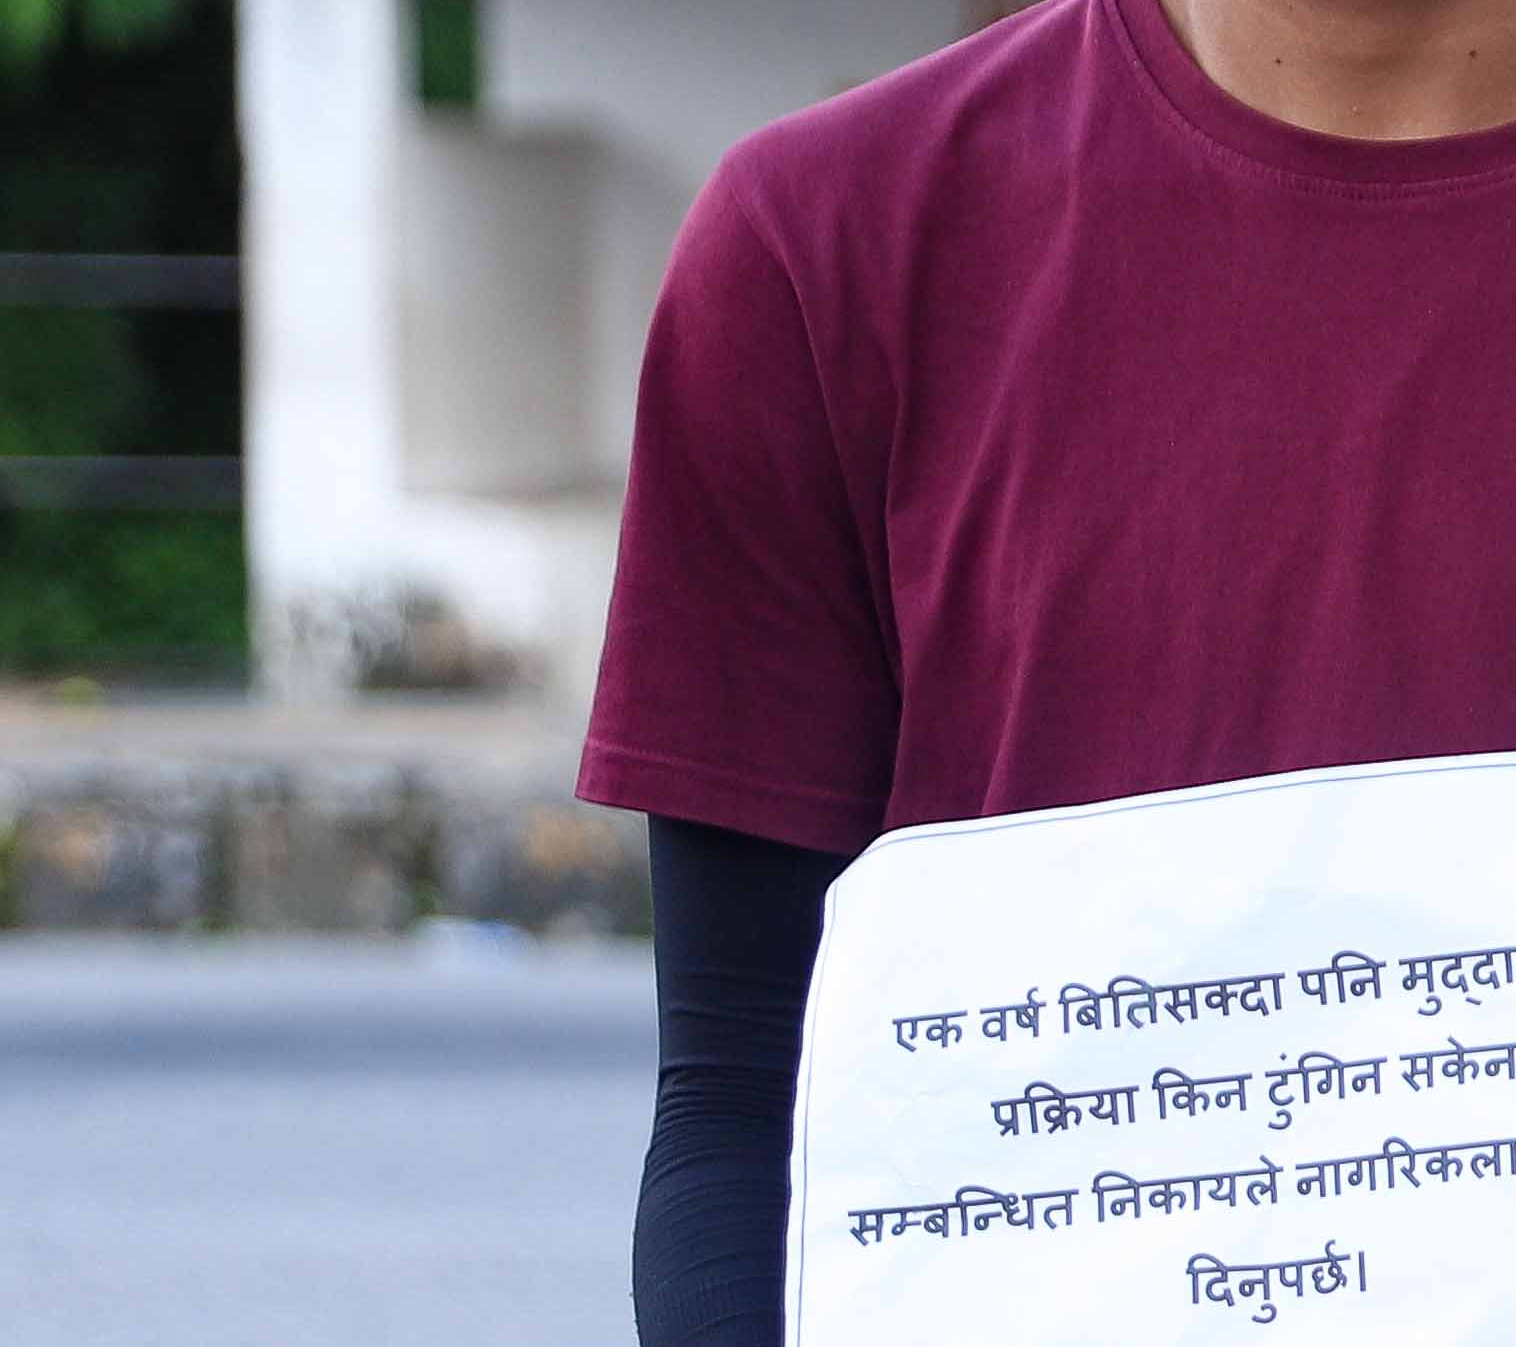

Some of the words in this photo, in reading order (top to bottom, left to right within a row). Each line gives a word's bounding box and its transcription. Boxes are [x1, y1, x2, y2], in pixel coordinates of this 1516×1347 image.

[892, 1010, 968, 1052] एक
[979, 987, 1047, 1041] वर्ष
[1058, 974, 1286, 1034] बितिसक्दा
[1297, 950, 1387, 1006] पनि
[991, 1080, 1139, 1137] प्रक्रिया
[1152, 1067, 1252, 1119] किन
[1265, 1050, 1387, 1131] टुंगिन
[848, 1185, 1079, 1246] सम्बन्धित
[1091, 1155, 1284, 1223] निकायले
[1185, 1240, 1367, 1324] दिनुपर्छ।
